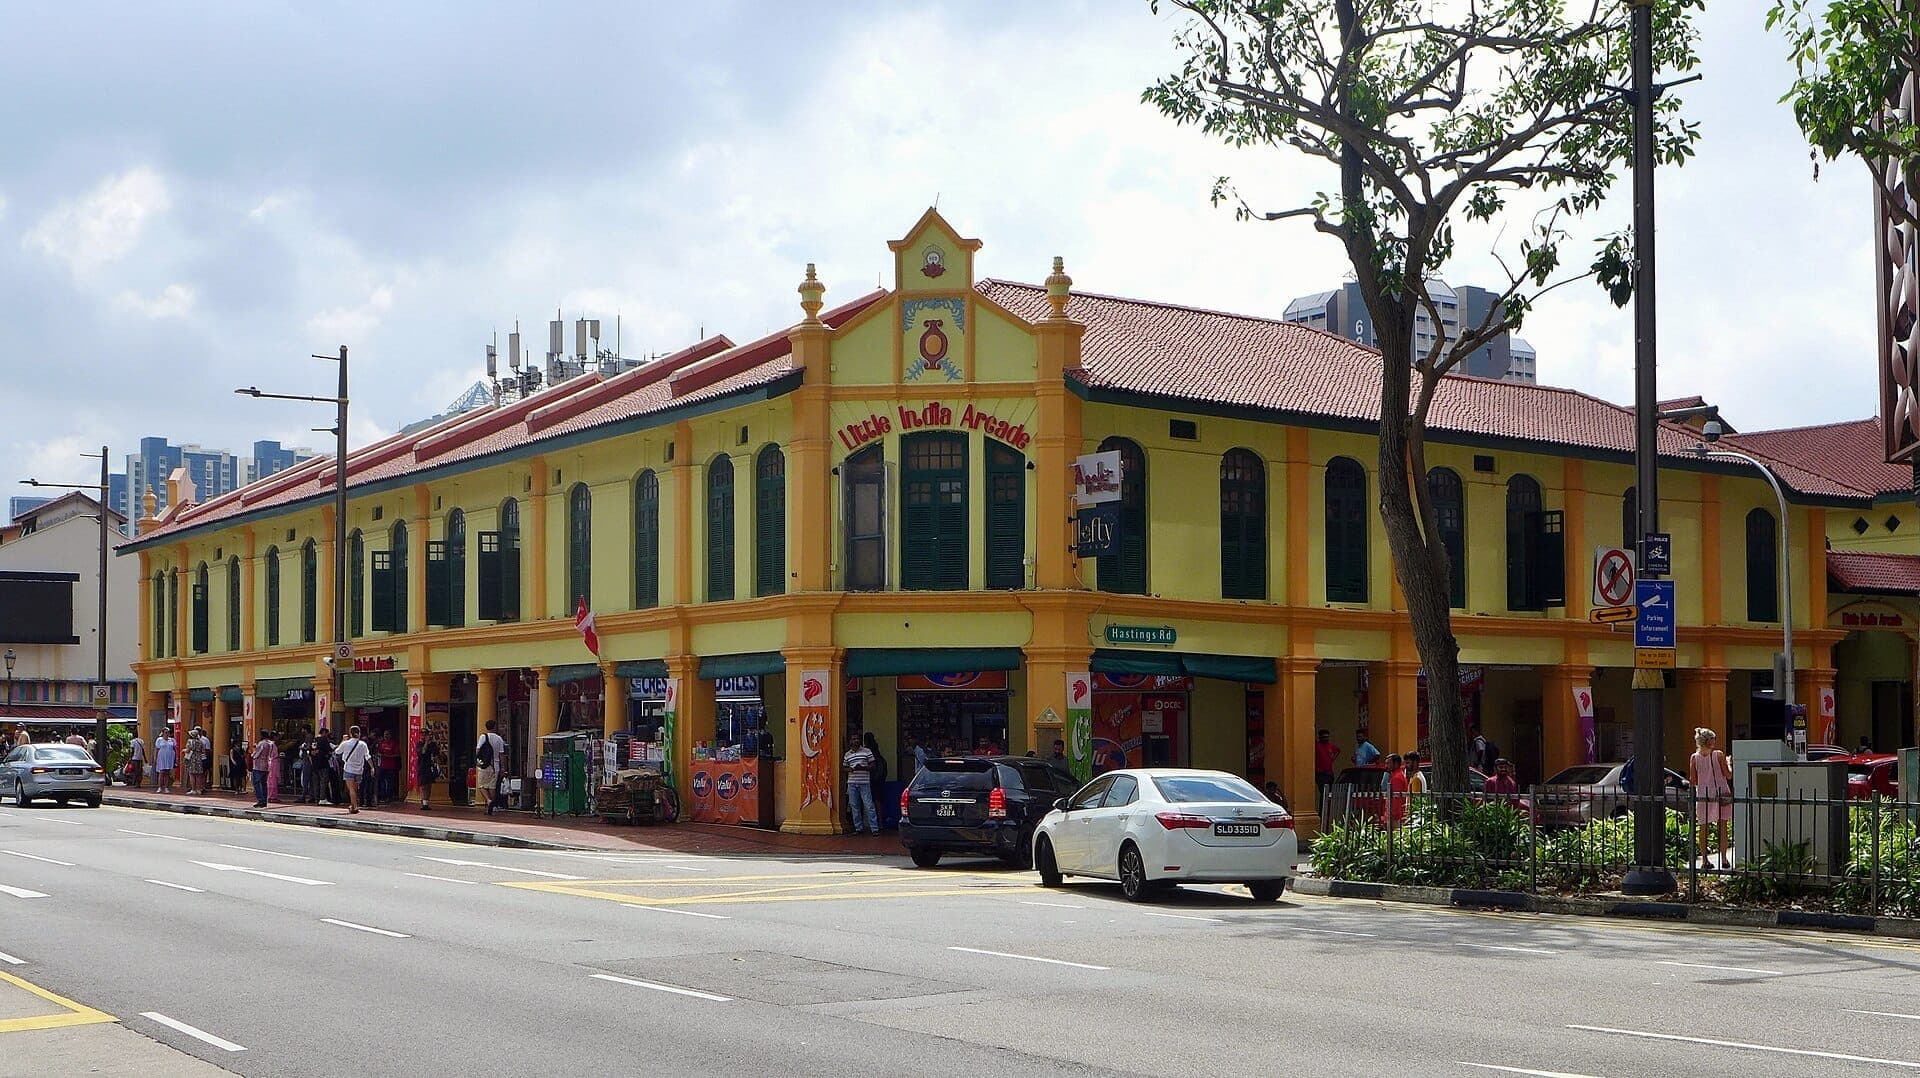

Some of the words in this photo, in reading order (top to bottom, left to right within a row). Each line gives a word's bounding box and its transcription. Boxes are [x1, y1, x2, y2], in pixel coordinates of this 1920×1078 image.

[837, 414, 891, 450] Little
[898, 402, 952, 430] India
[960, 404, 1031, 450] Arcade
[1646, 614, 1664, 625] Parking
[1112, 627, 1158, 642] Hastings
[1159, 629, 1171, 640] Rd
[1641, 625, 1669, 633] Enforcement
[1216, 825, 1259, 834] SLD3351D
